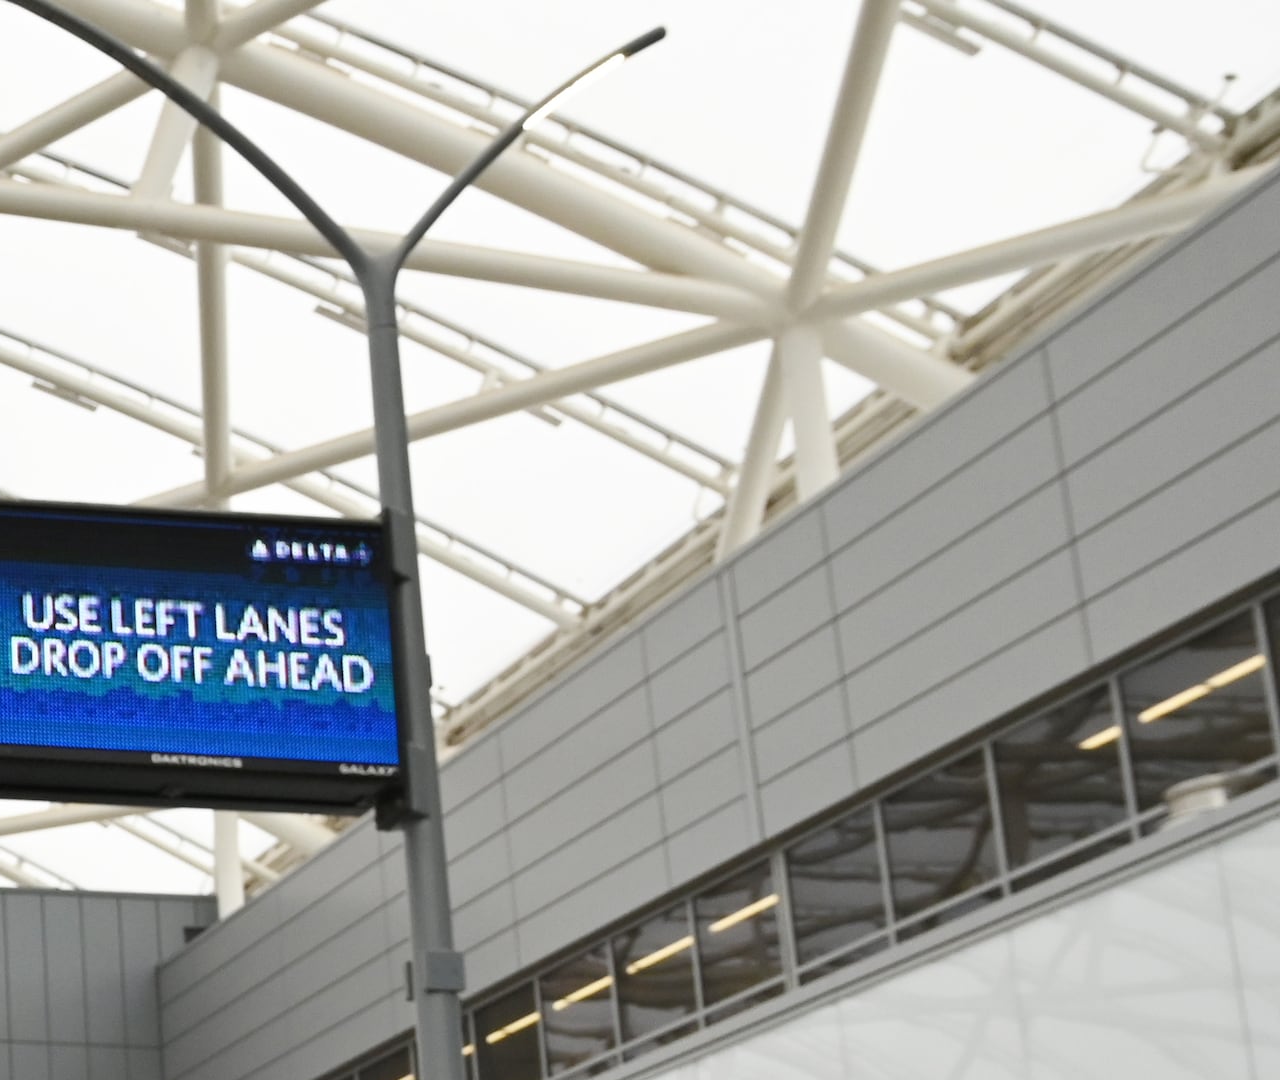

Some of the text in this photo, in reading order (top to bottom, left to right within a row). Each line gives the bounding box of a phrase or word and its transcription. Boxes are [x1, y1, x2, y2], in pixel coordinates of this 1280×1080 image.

[275, 540, 350, 562] DELTA
[22, 591, 345, 647] USE LEFT LANES
[10, 636, 375, 693] DROP OFF AHEAD
[151, 752, 243, 769] DAKTRONICS
